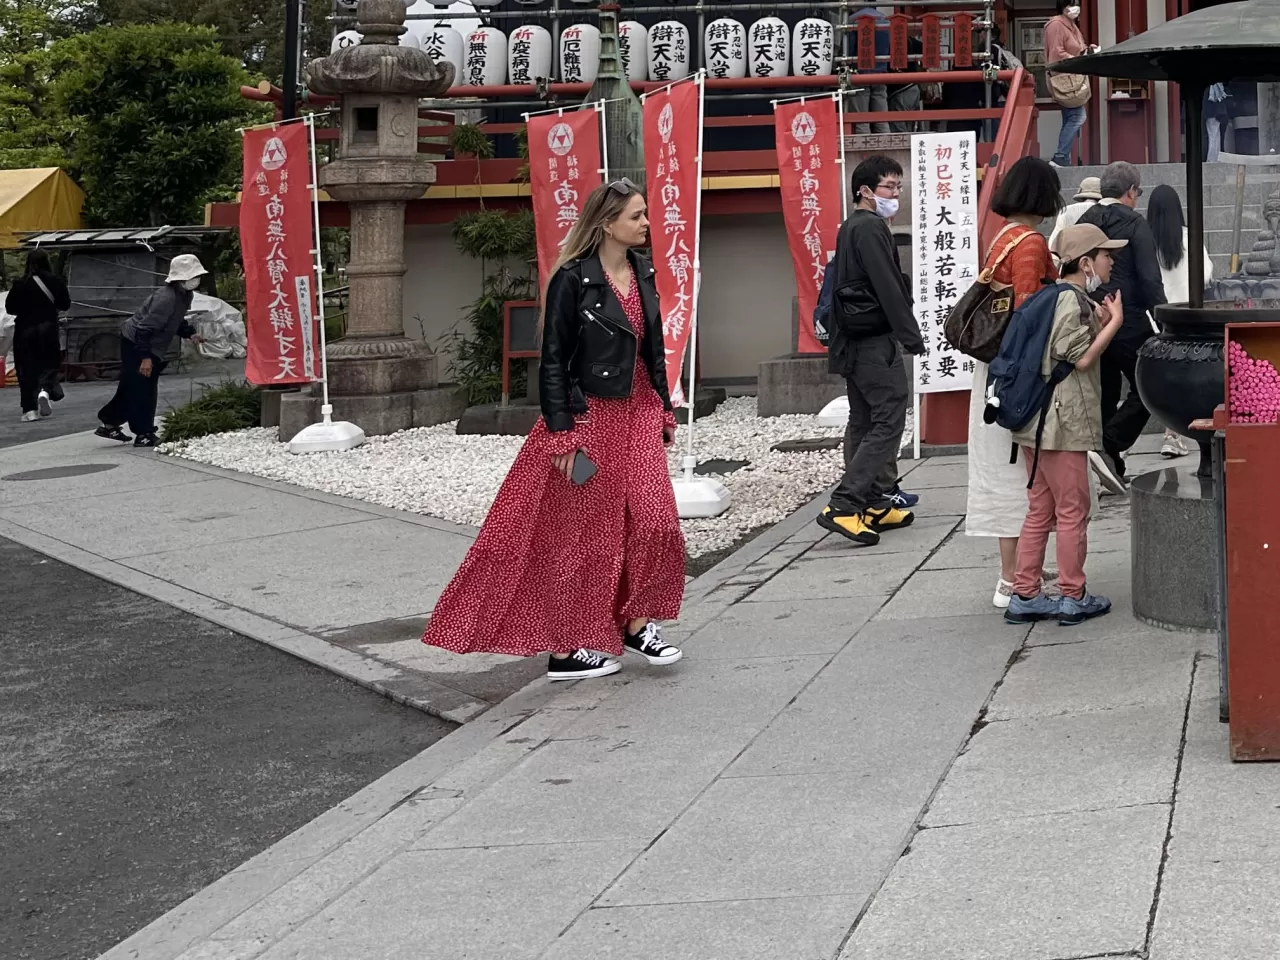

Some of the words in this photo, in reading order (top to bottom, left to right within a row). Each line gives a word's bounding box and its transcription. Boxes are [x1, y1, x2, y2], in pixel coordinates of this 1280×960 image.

[511, 27, 534, 86] 祈疫病退
[673, 25, 687, 63] 不忍池
[730, 23, 743, 59] 不忍池
[774, 23, 787, 61] 不忍池
[822, 24, 832, 63] 不忍池
